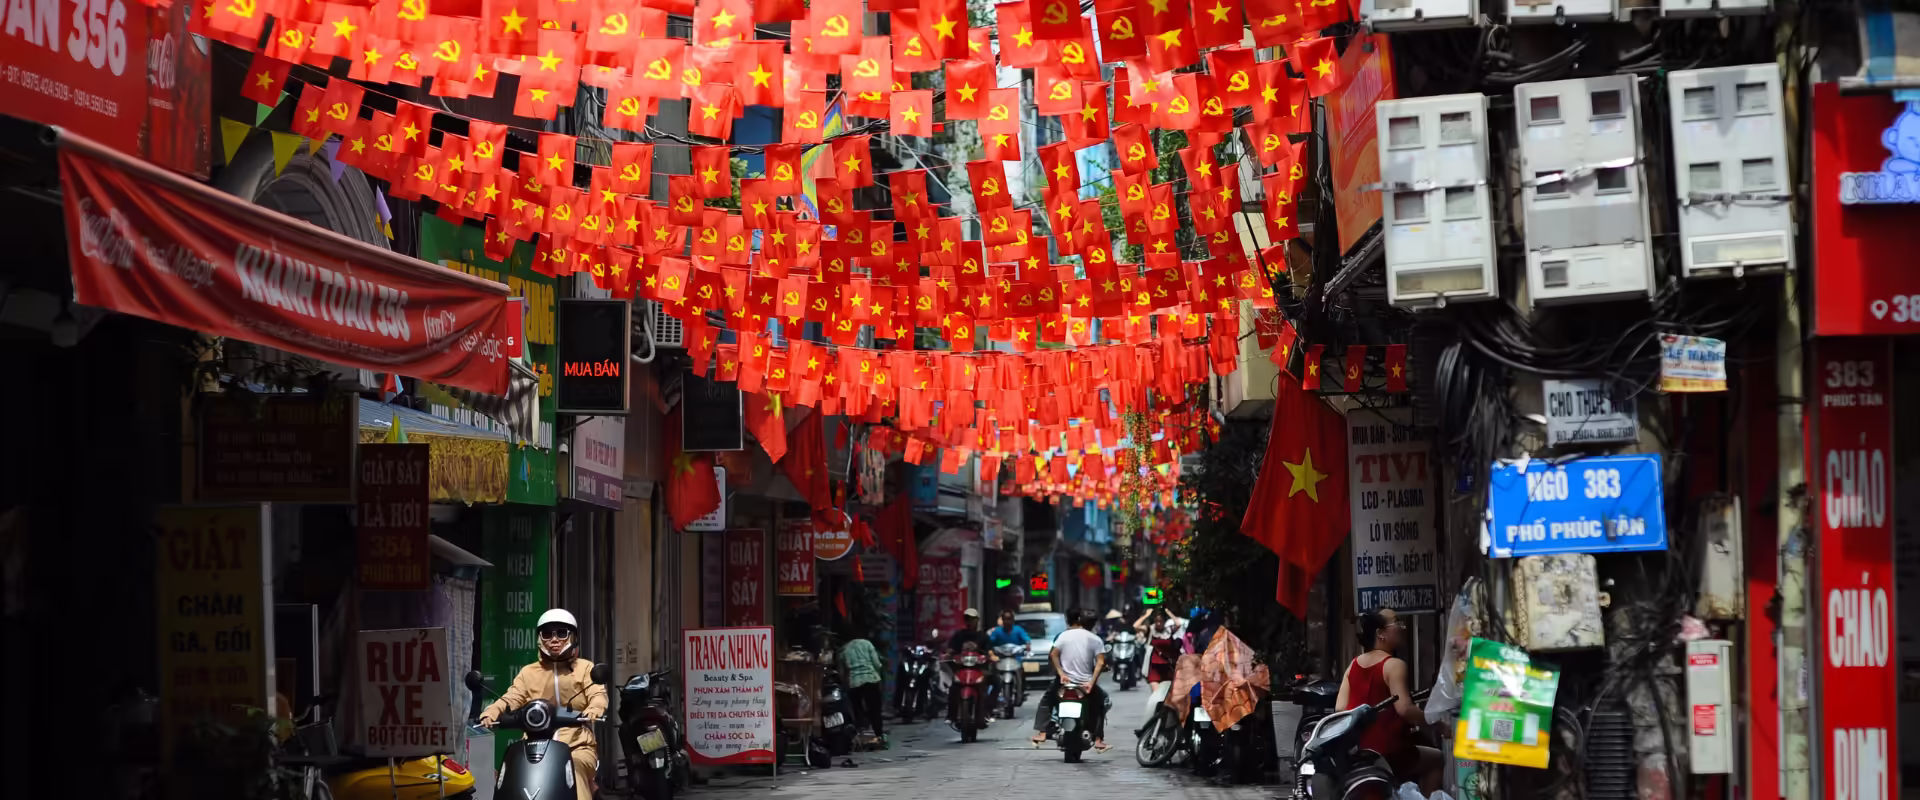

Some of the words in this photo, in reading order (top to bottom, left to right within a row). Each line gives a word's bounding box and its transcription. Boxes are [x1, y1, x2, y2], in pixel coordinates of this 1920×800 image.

[67, 0, 127, 76] 356
[376, 284, 411, 342] 356
[564, 361, 592, 377] MUA
[594, 357, 620, 377] BÁN
[1825, 361, 1875, 388] 383
[1550, 391, 1573, 418] CHO
[1355, 451, 1428, 484] TIVI
[1825, 431, 1886, 529] CHÁO
[1525, 464, 1569, 503] NGÕ
[1583, 468, 1622, 500] 383
[1362, 491, 1379, 510] LCD
[1387, 488, 1425, 508] PLASMA
[1370, 519, 1381, 542] LÒ
[1383, 522, 1392, 541] VI
[1506, 517, 1547, 543] PHỐ
[1551, 516, 1602, 540] PHÚC
[779, 556, 810, 582] SẤY
[1357, 550, 1374, 575] BẾP
[1827, 569, 1889, 668] CHÁO
[366, 629, 441, 683] RỬA
[689, 634, 727, 671] TRANG
[727, 633, 768, 670] NHUNG
[704, 674, 729, 682] Beauty
[738, 673, 754, 682] Spa
[378, 684, 424, 726] XE
